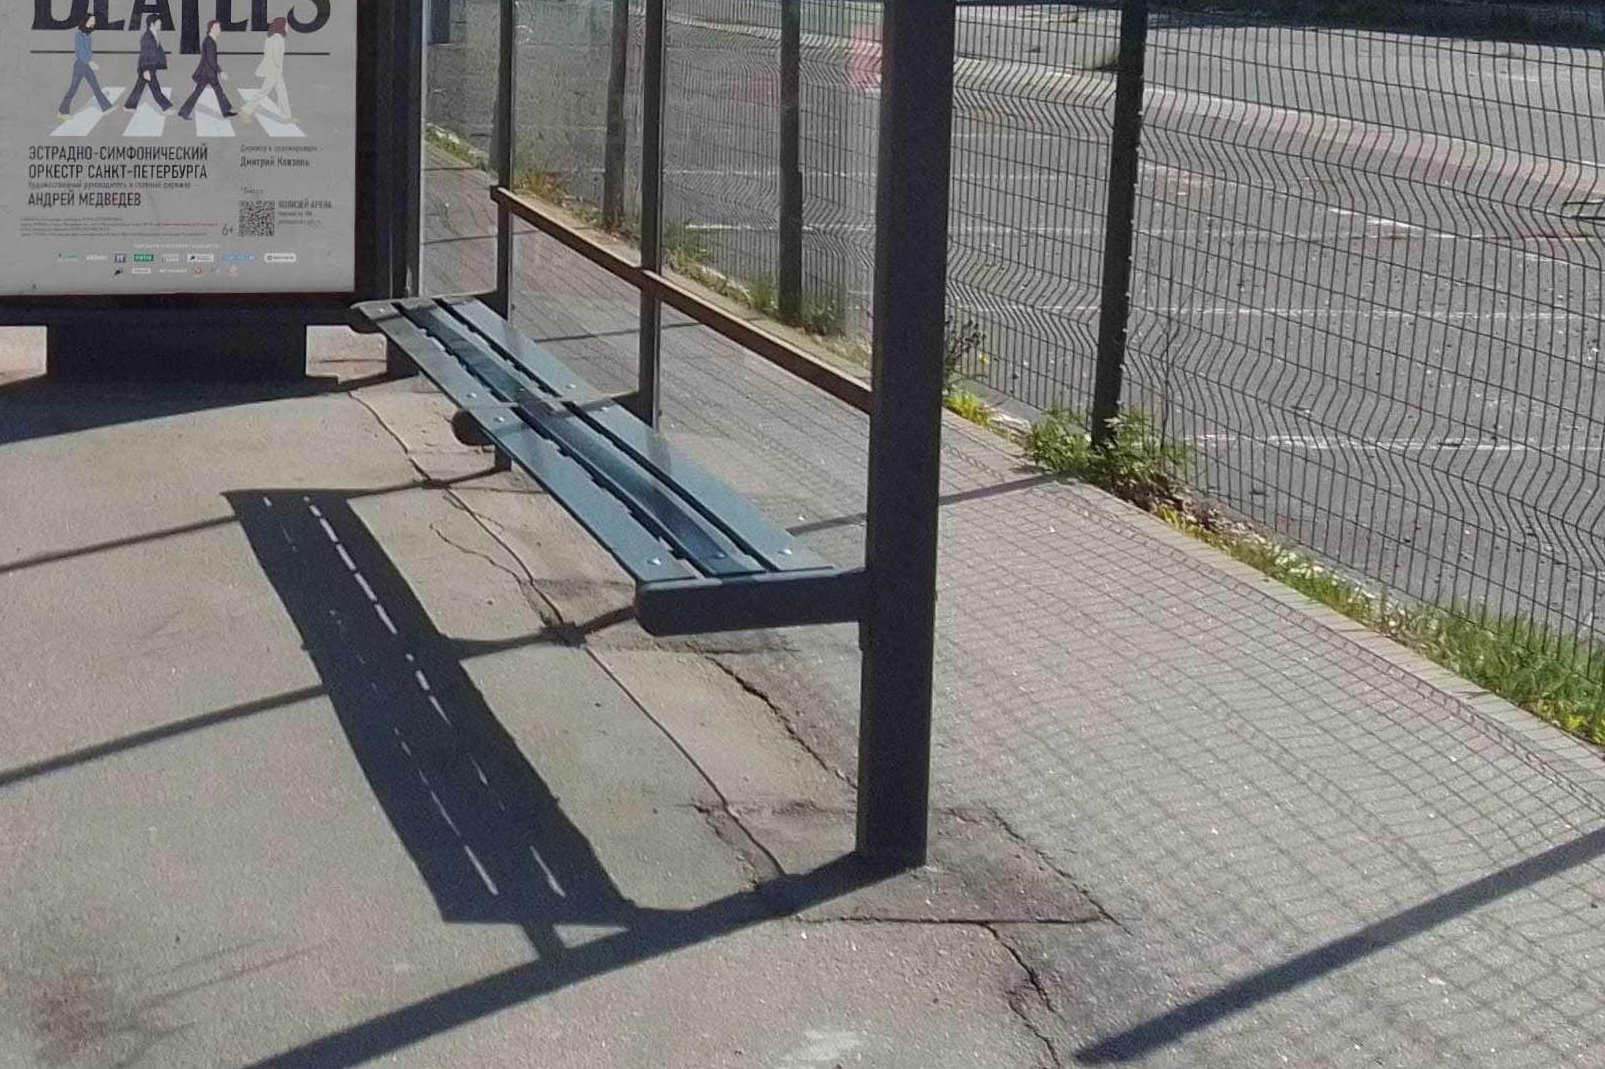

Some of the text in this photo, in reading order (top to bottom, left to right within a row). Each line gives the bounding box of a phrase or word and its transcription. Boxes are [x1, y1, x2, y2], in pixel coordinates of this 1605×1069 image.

[29, 143, 208, 162] ЭСТРАДНО-СИМФОНИЧЕСКИЙ
[29, 164, 208, 179] ОРКЕСТР САНКТ-ПЕТЕРБУРГА
[28, 190, 141, 208] АНДРЕЙ МЕДВЕДЕВ
